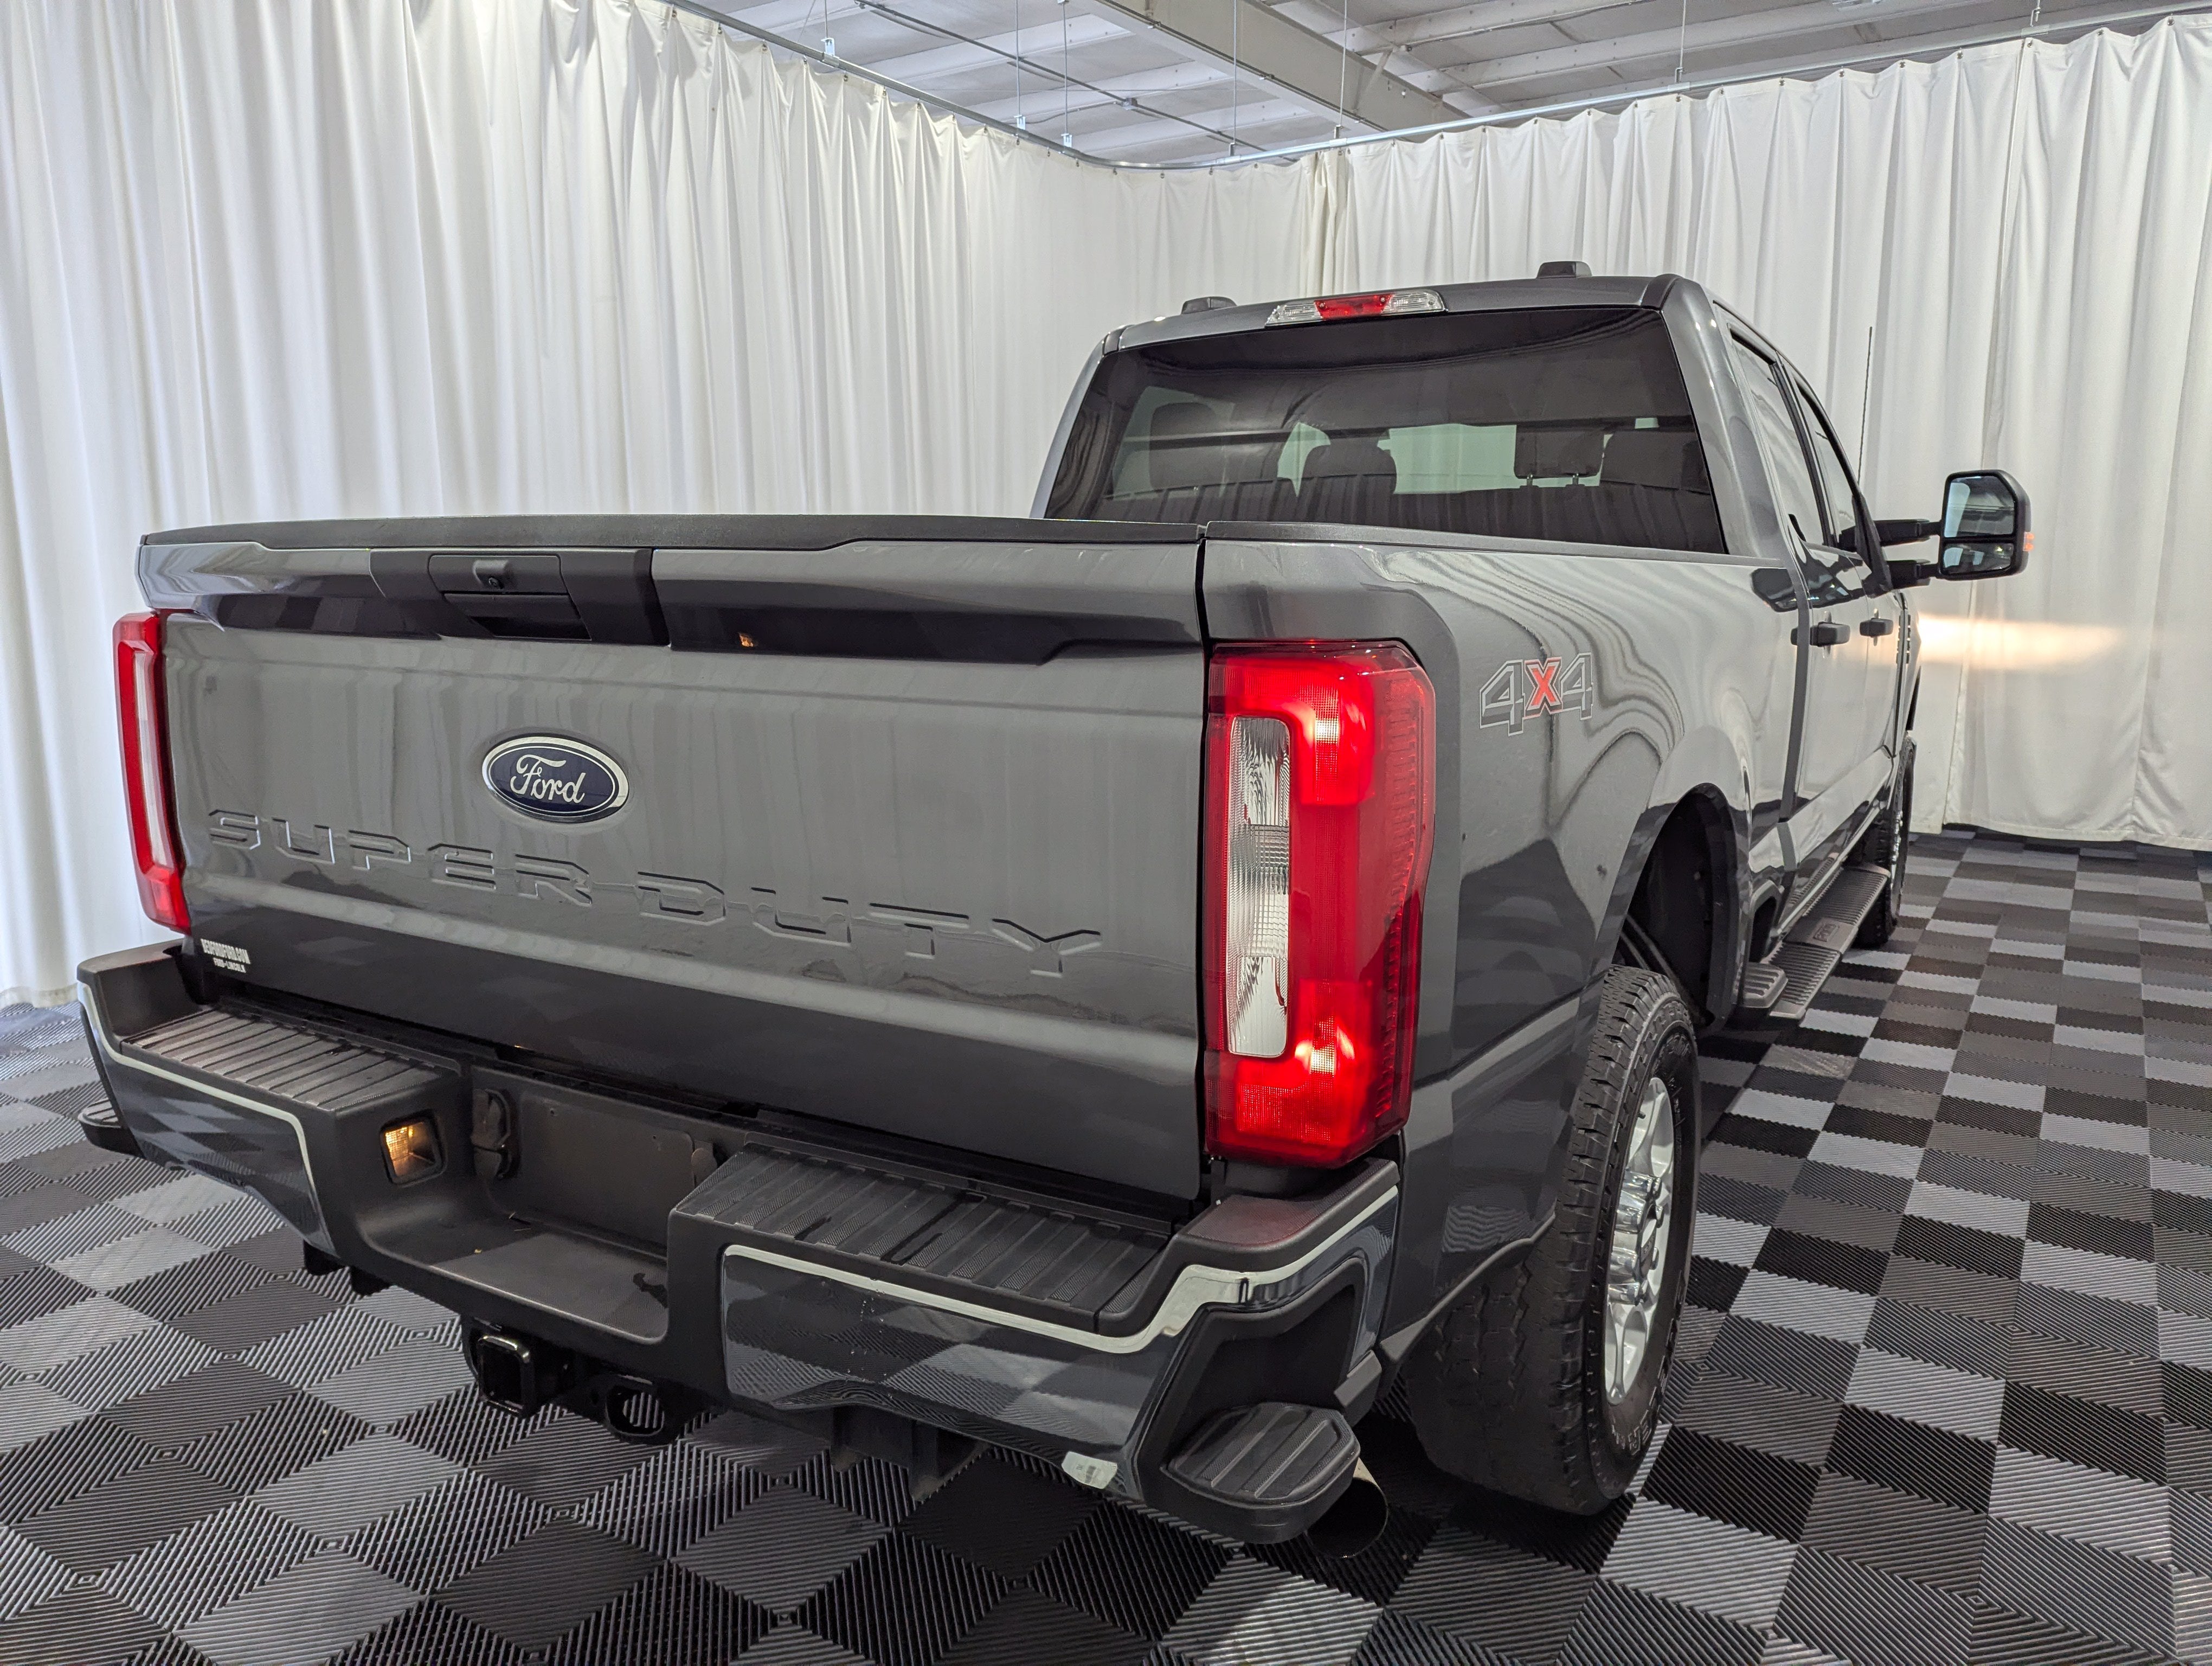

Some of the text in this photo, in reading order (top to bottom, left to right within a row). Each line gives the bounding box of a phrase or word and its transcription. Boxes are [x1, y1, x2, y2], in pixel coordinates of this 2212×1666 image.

[510, 754, 586, 804] Ford
[209, 809, 1102, 978] SUPER DUTY
